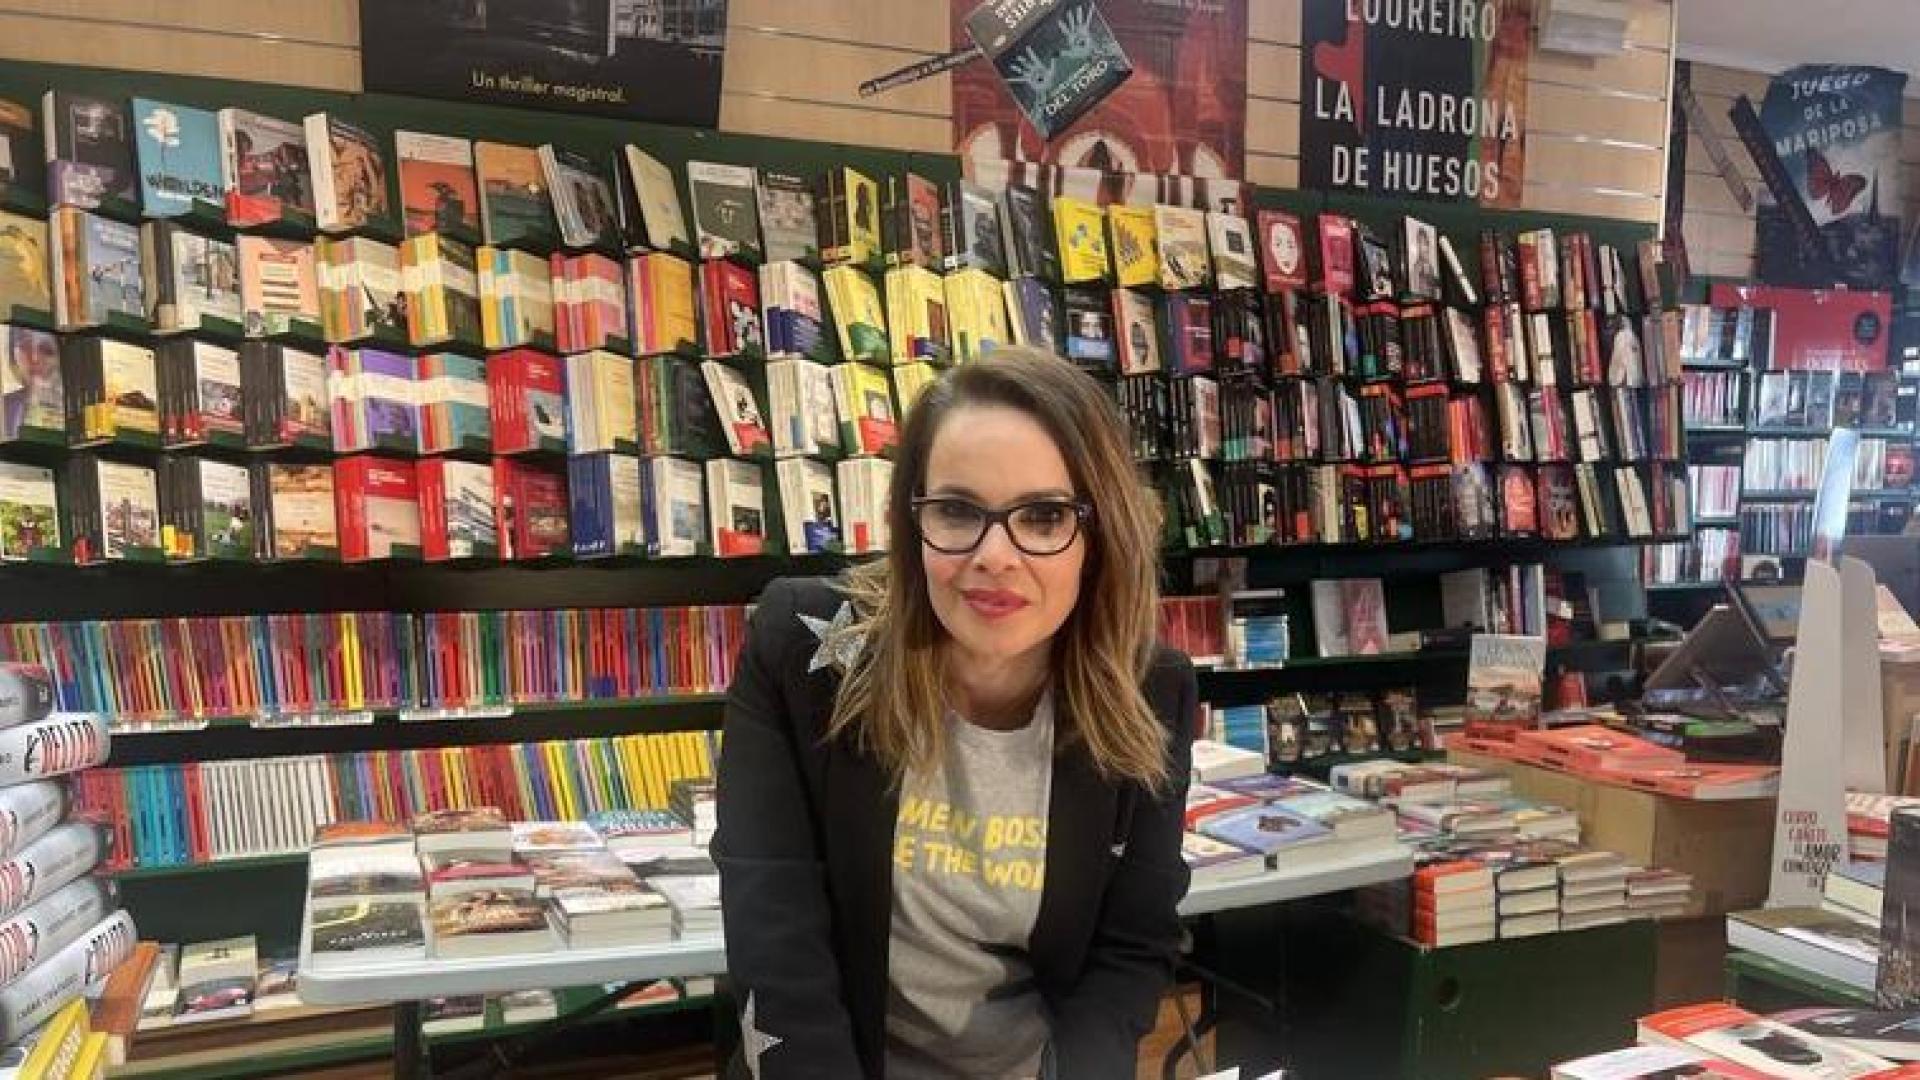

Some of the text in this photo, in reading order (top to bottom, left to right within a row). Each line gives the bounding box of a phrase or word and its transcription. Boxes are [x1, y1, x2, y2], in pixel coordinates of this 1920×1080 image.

[1346, 0, 1496, 41] LOUREIRO
[472, 69, 494, 87] Un
[499, 70, 550, 94] thriller
[1072, 60, 1108, 93] TORO
[1791, 72, 1871, 101] JUEGO
[1316, 75, 1517, 141] LA LADRONA
[1775, 112, 1882, 156] MARIPOSA
[1332, 144, 1500, 199] DE HUESOS
[923, 842, 978, 873] THE
